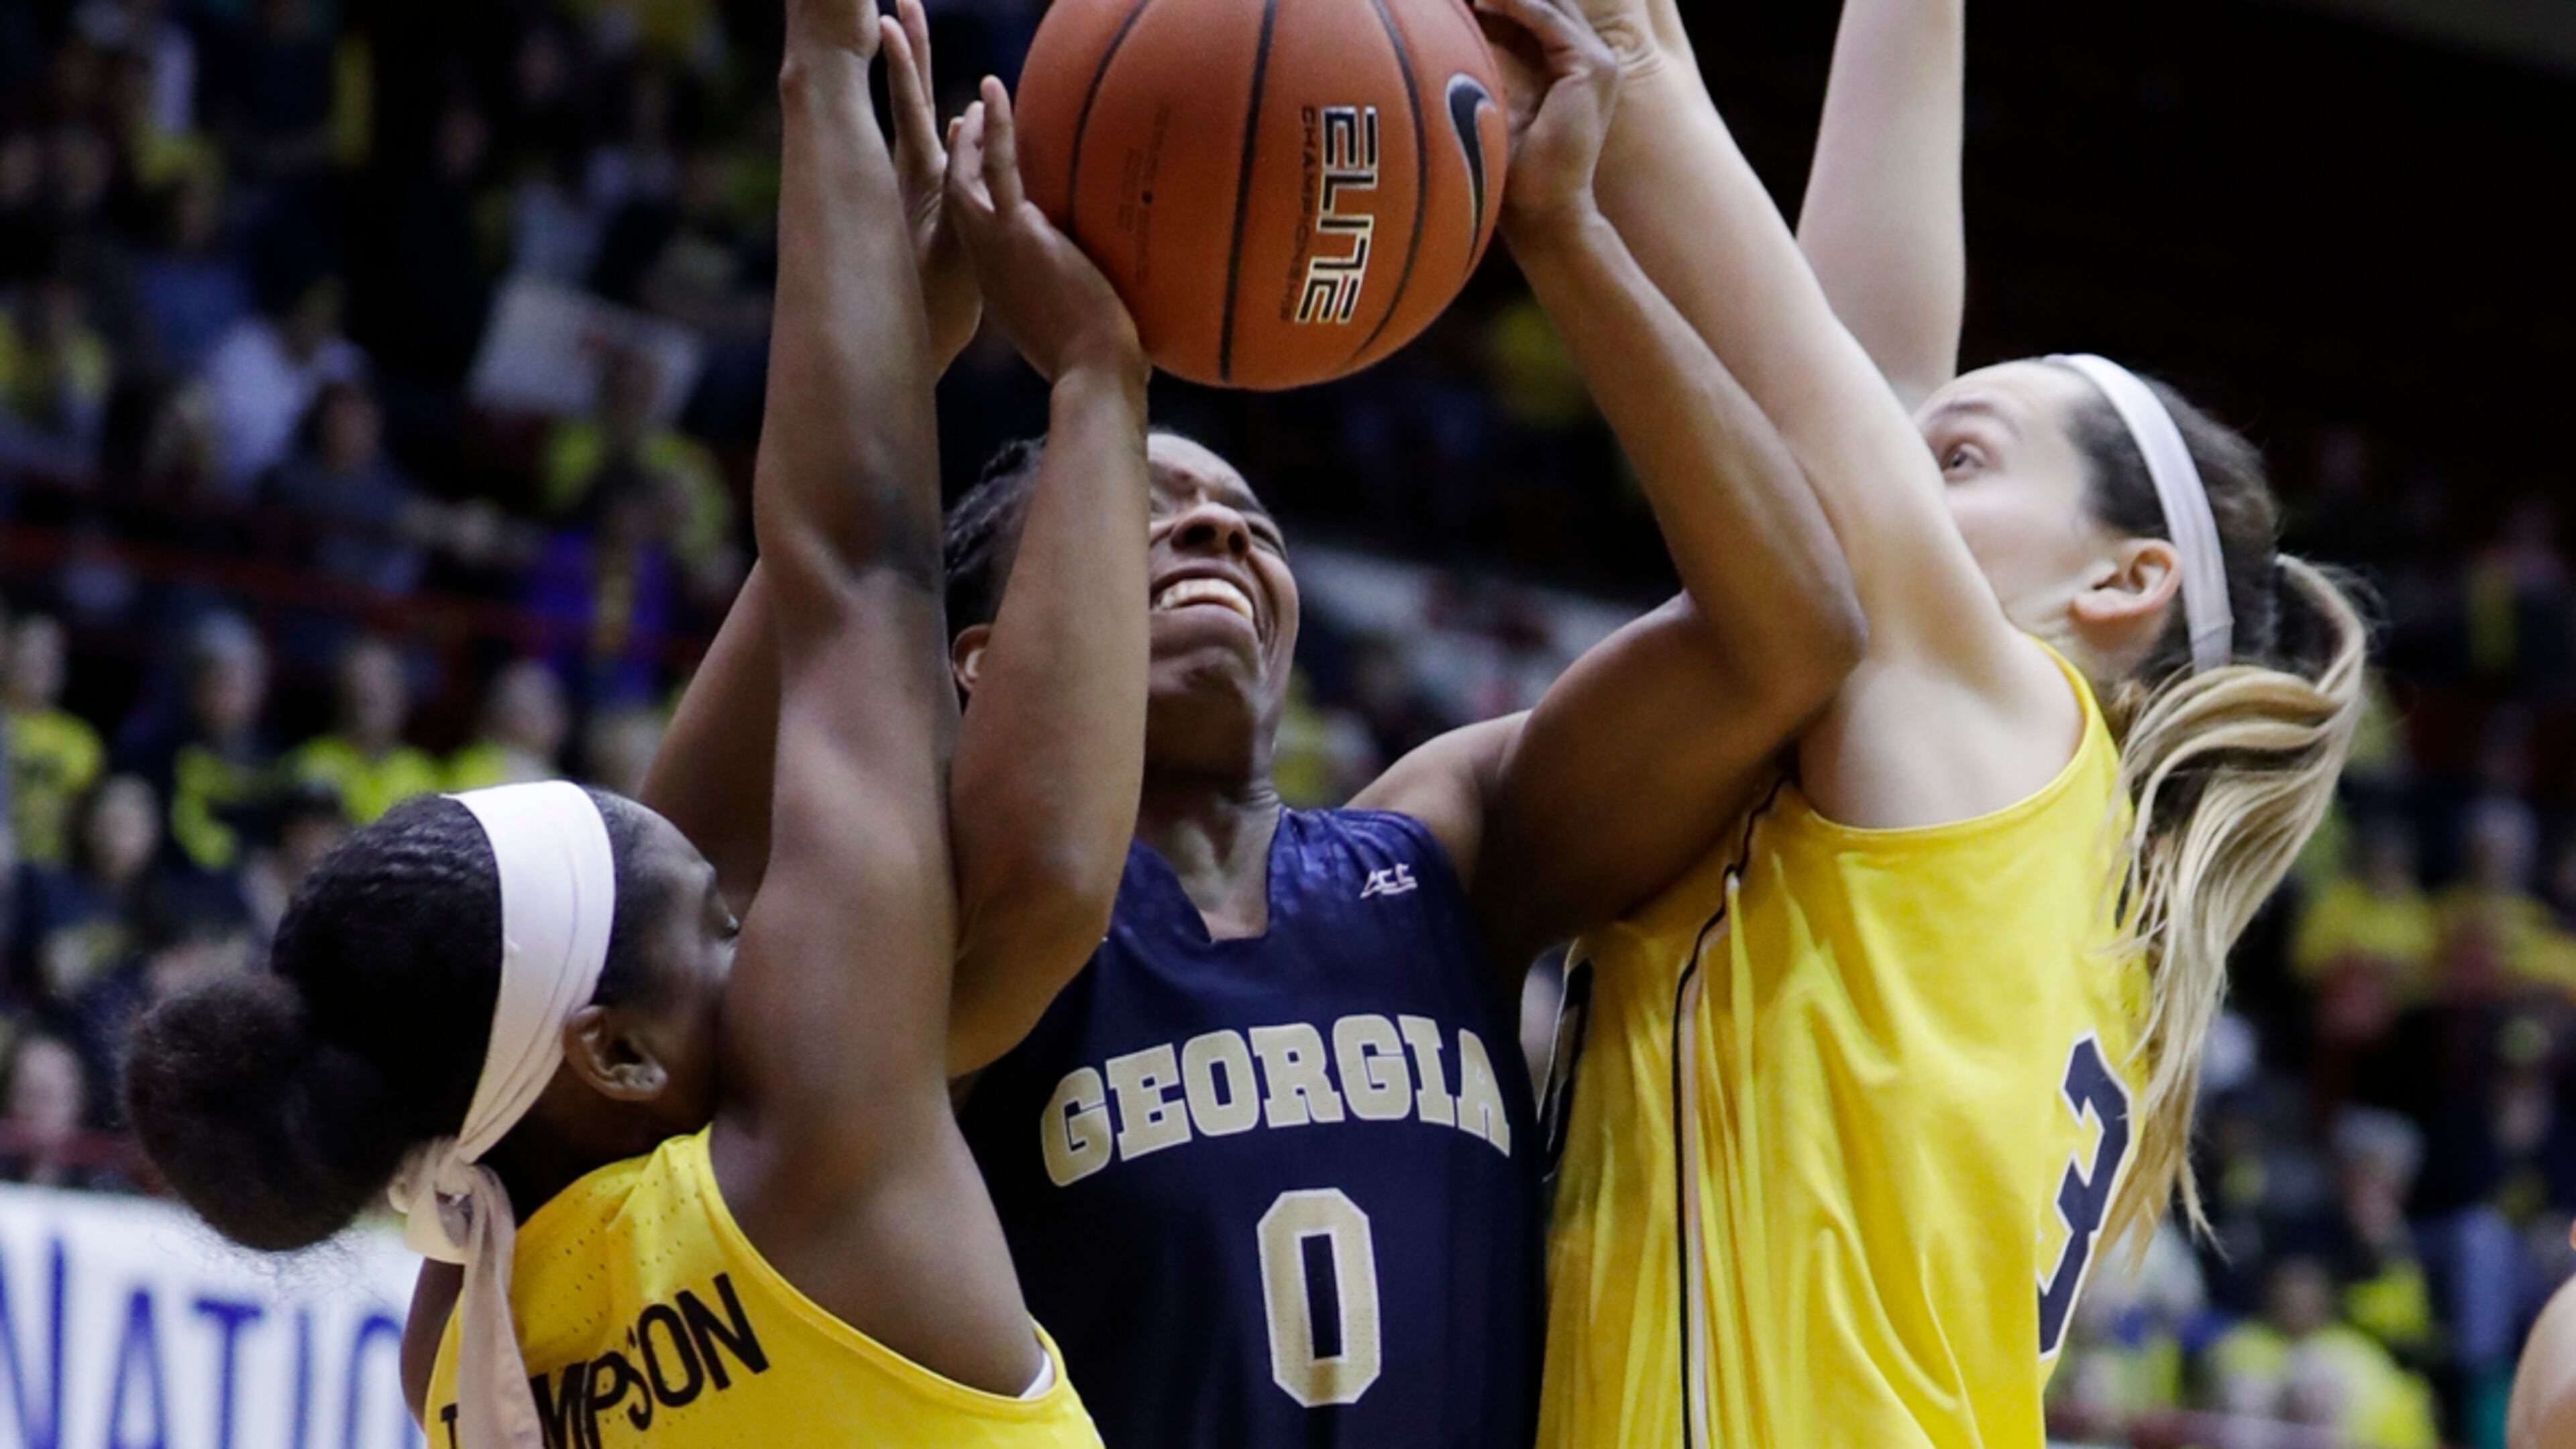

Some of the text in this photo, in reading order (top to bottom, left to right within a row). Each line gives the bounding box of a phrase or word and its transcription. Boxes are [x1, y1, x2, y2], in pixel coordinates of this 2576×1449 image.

[1294, 106, 1377, 325] ELITE
[1041, 1014, 1511, 1187] GEORGIA
[2035, 1028, 2133, 1362] 3
[1256, 1188, 1381, 1408] 0
